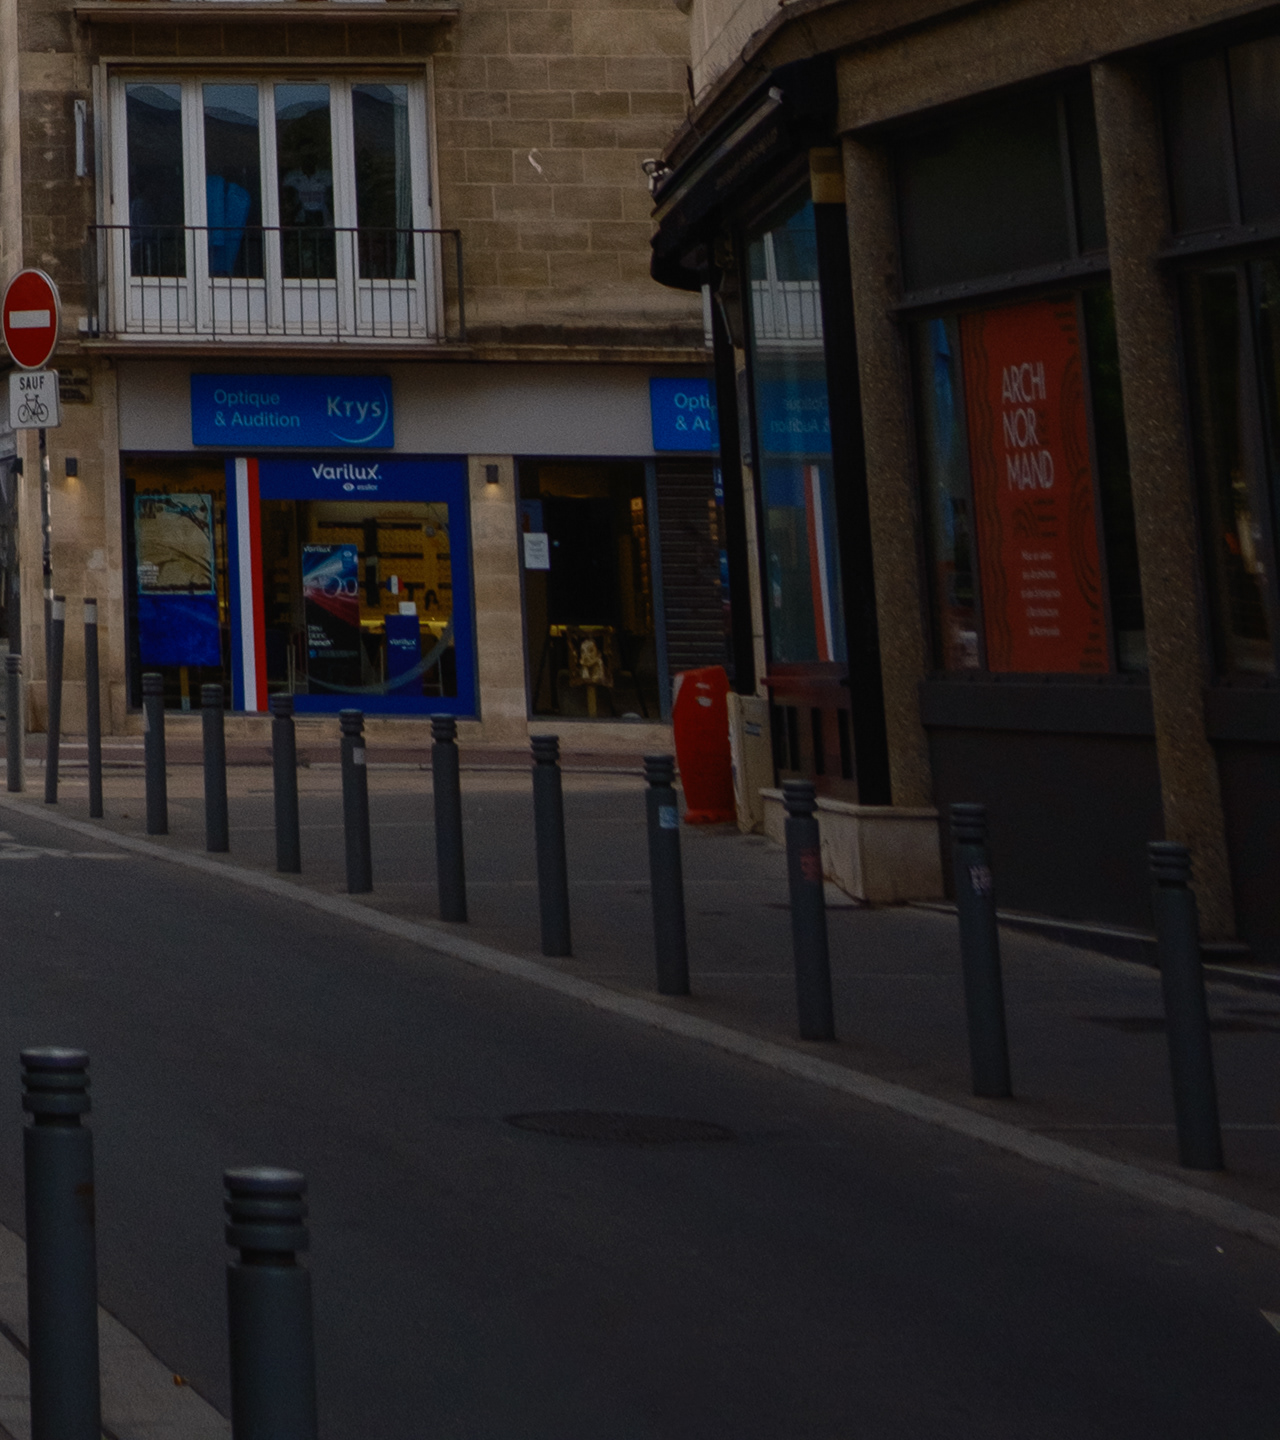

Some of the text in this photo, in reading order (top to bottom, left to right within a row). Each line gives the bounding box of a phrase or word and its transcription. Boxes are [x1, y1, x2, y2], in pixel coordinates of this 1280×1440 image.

[19, 375, 45, 391] SAUF
[1002, 360, 1046, 404] ARCHI
[214, 389, 280, 407] Optique
[674, 393, 711, 412] Opti
[214, 412, 301, 427] & Audition
[327, 396, 381, 424] Krys
[1002, 408, 1039, 448] NOR
[1006, 450, 1054, 491] MAND
